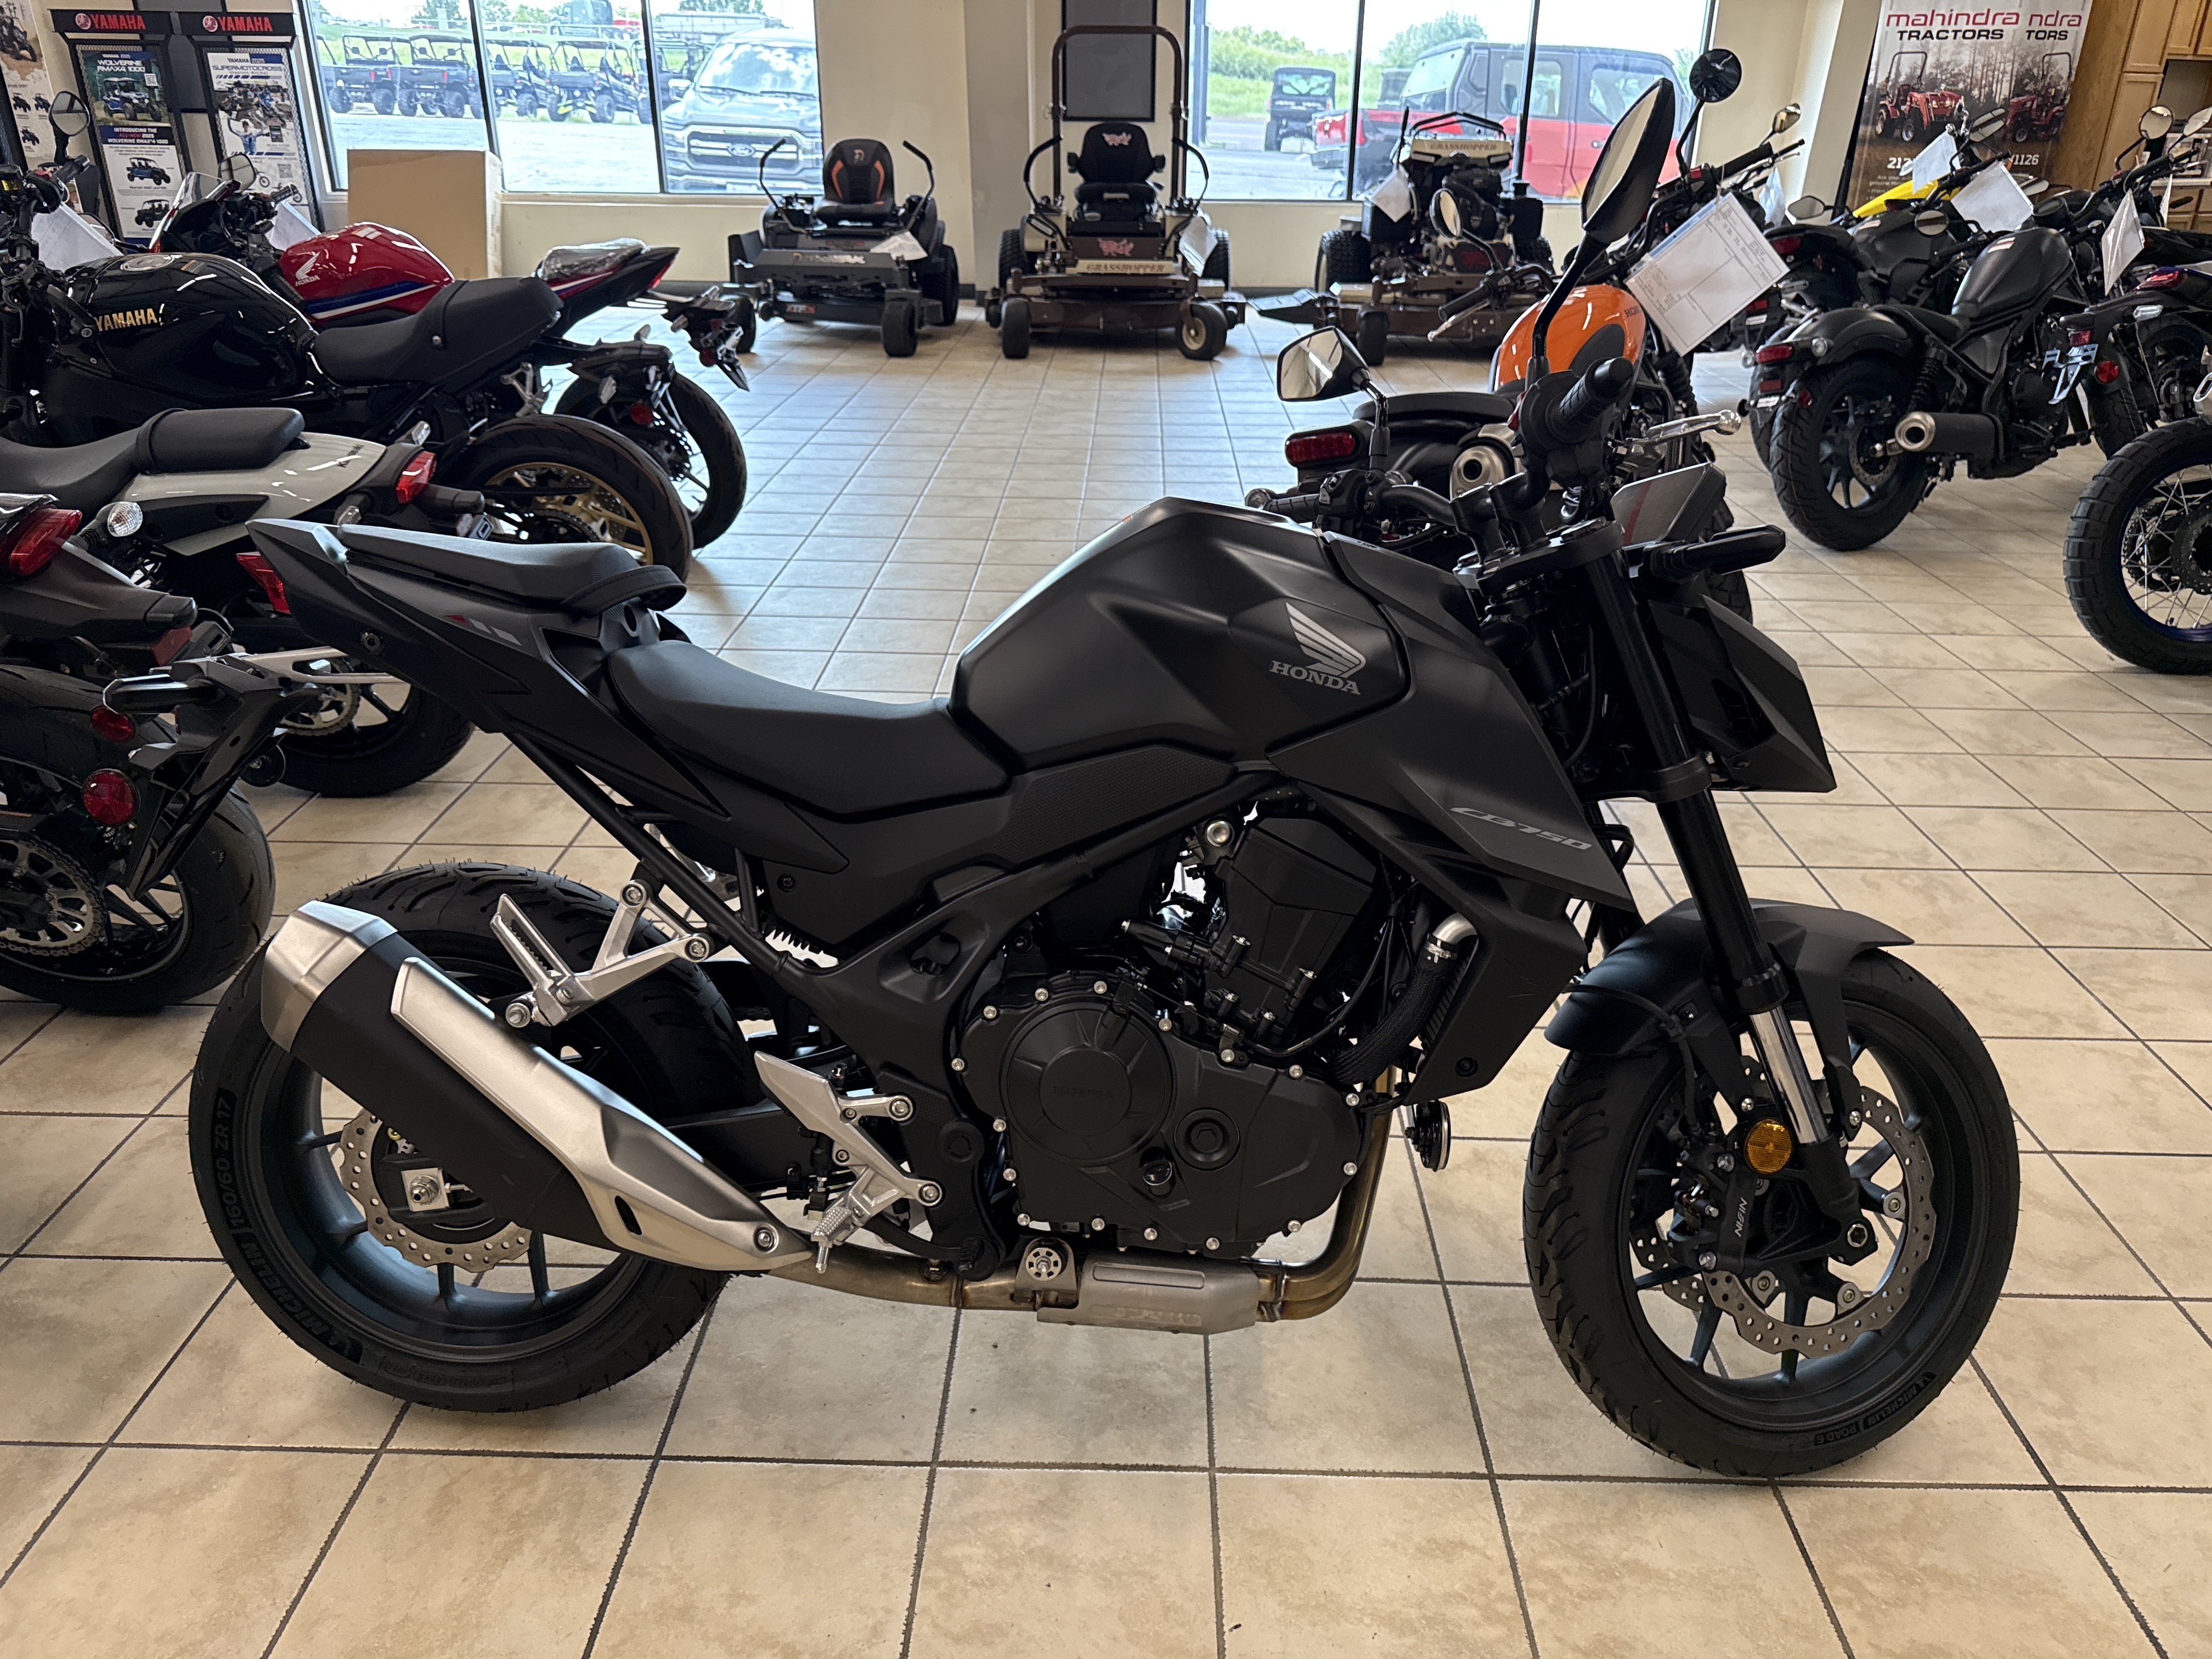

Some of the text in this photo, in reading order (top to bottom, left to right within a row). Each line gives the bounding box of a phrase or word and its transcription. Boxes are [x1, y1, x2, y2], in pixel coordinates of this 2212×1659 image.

[89, 14, 146, 30] YAMAHA
[217, 16, 273, 32] YAMAHA
[1886, 8, 2020, 27] mahindra
[2028, 10, 2082, 27] ndra
[1897, 29, 2004, 41] TRACTORS
[2025, 30, 2068, 41] TORS
[1086, 263, 1165, 272] GRASSHOPPER
[295, 275, 321, 286] HONDA
[92, 308, 158, 332] YAMAHA
[1269, 660, 1361, 695] HONDA
[1450, 807, 1592, 850] CB750
[215, 1097, 245, 1227] 160/60 ZR 17
[239, 1239, 330, 1337] MICHELIN
[1867, 1387, 1917, 1426] MICHELIN
[1826, 1424, 1857, 1442] ROAD
